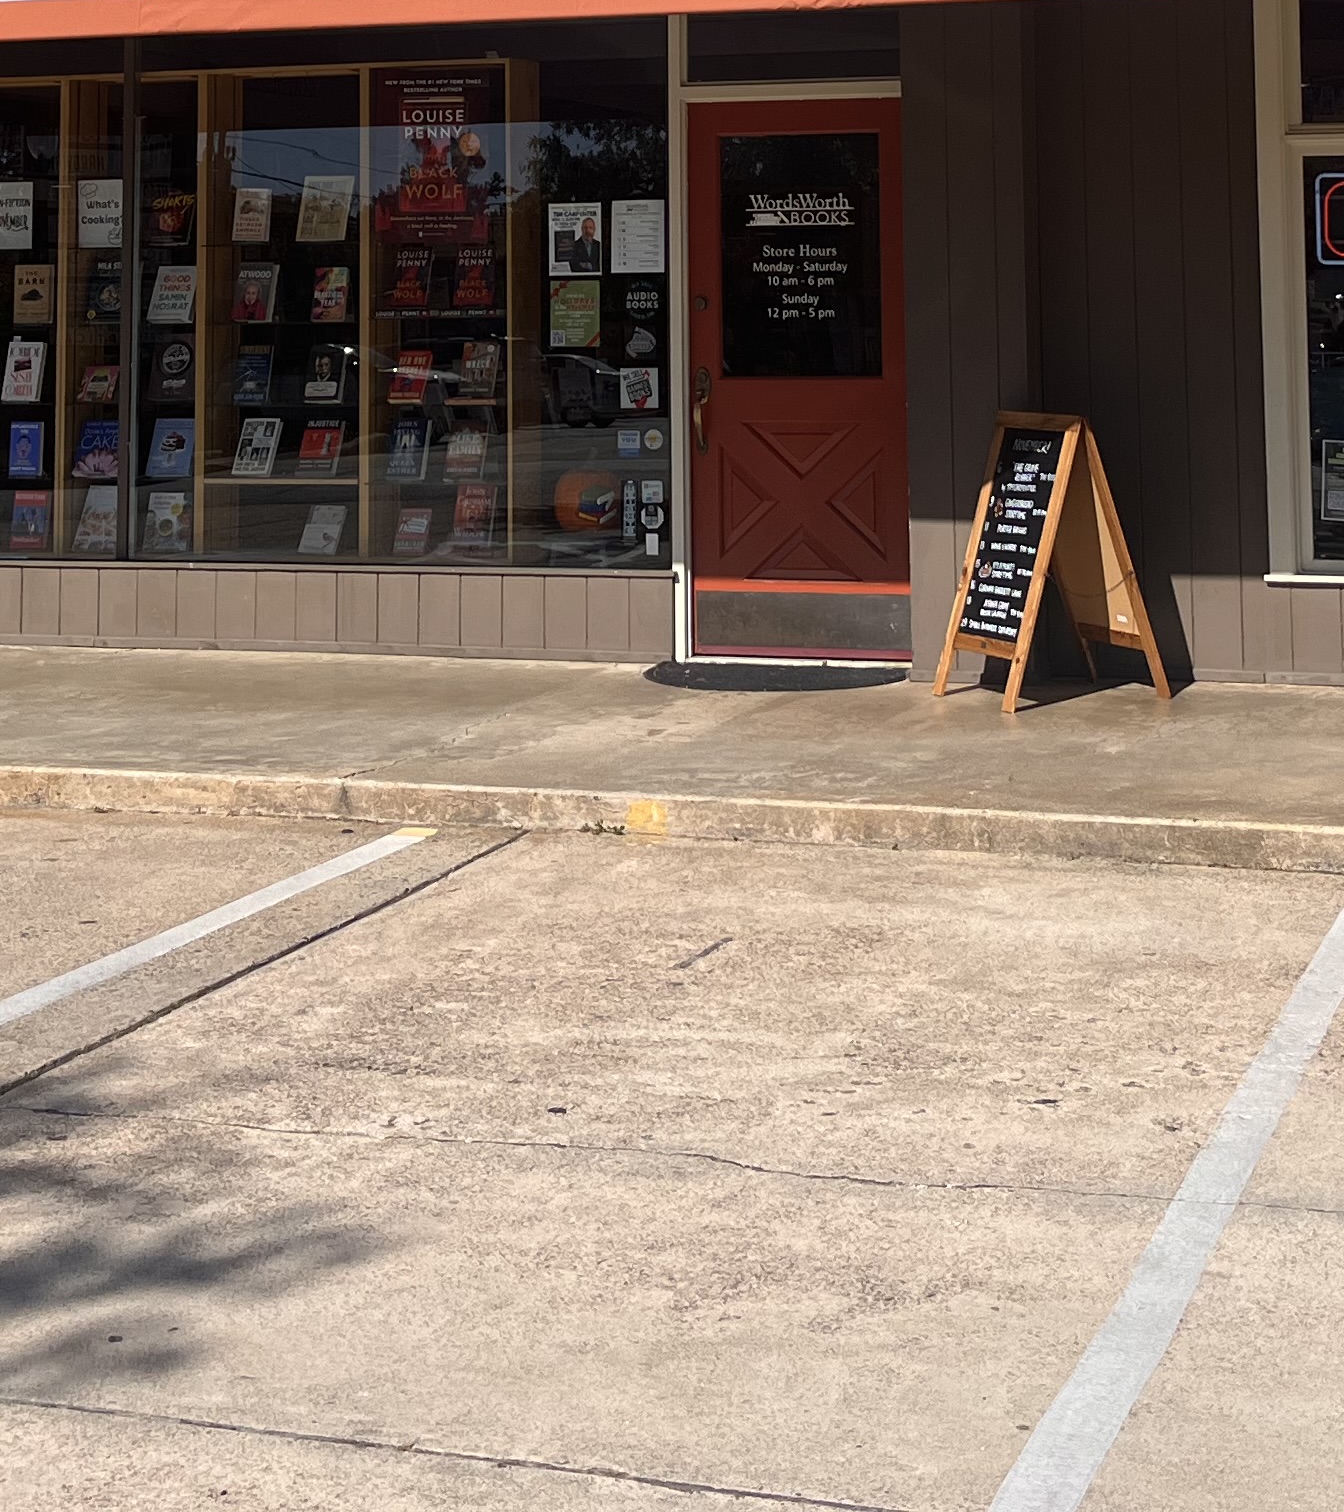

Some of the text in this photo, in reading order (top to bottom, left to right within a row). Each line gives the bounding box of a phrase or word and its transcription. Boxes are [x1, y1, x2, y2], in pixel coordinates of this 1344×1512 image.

[402, 109, 464, 123] LOUISE
[404, 126, 463, 139] PENNY
[409, 167, 459, 179] BLACK
[405, 183, 463, 200] WOLF
[85, 199, 120, 210] What's
[749, 192, 850, 209] WordsWorth
[791, 211, 849, 226] BOOKS
[397, 250, 430, 260] LOUISE
[458, 249, 494, 258] LOUISE
[762, 244, 837, 257] Store Hours
[396, 259, 428, 268] PENNY
[458, 257, 492, 267] PENNY
[753, 262, 794, 274] Monday
[803, 261, 848, 274] Saturday
[163, 274, 191, 282] GOOD
[239, 270, 272, 279] ATWOOD
[18, 277, 46, 286] BARN
[767, 276, 780, 286] 10
[782, 277, 799, 286] am
[807, 275, 815, 286] 6
[817, 277, 835, 288] pm
[159, 284, 191, 292] THINGS
[158, 293, 187, 301] SAMIN
[393, 289, 425, 299] WOLF
[456, 288, 490, 299] WOLF
[626, 291, 659, 300] AUDIO
[782, 293, 819, 305] Sunday
[152, 302, 189, 311] NOSRAT
[626, 300, 659, 309] BOOKS
[767, 308, 780, 318] 12
[782, 309, 799, 321] pm
[808, 308, 816, 318] 5
[818, 309, 836, 320] pm
[308, 420, 340, 428] INJUSTICE
